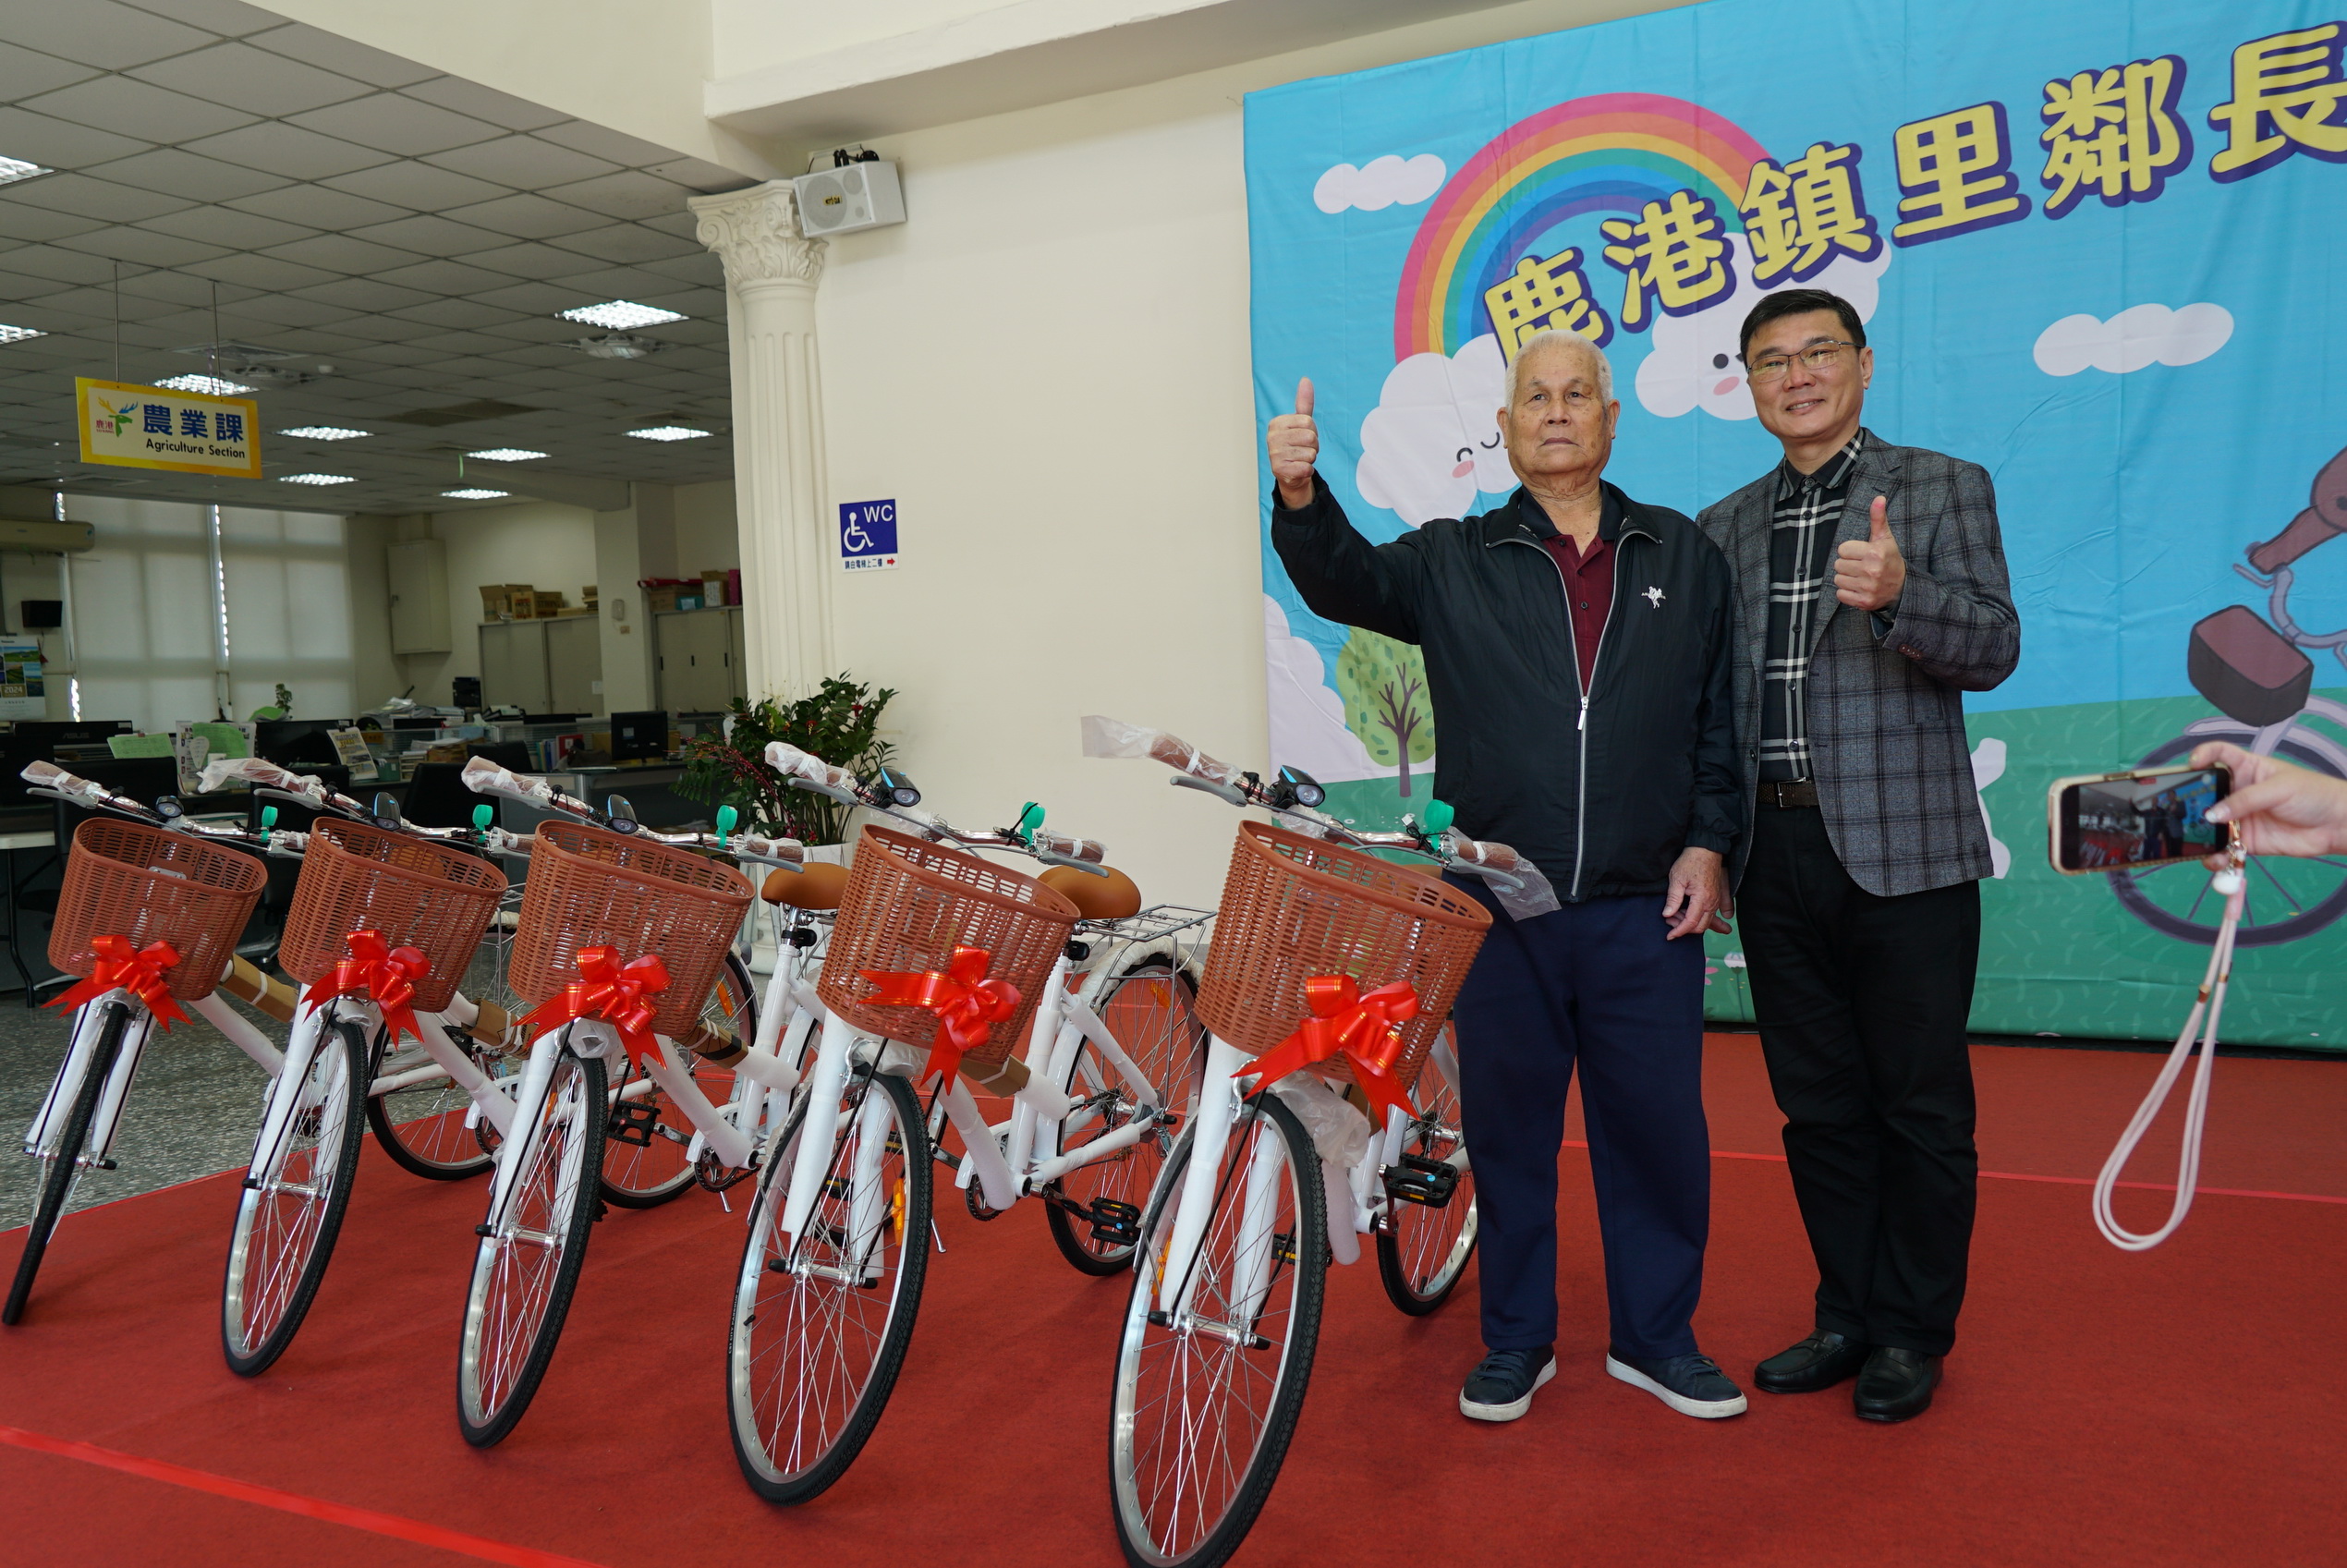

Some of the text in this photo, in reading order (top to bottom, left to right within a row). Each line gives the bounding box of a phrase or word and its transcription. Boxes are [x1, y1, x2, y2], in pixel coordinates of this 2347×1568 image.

[1482, 20, 2347, 368] 鹿港鎮里鄰長
[143, 404, 244, 443] 農業課
[146, 438, 245, 458] Agriculture Section
[863, 504, 894, 523] WC
[4, 686, 23, 694] 2024
